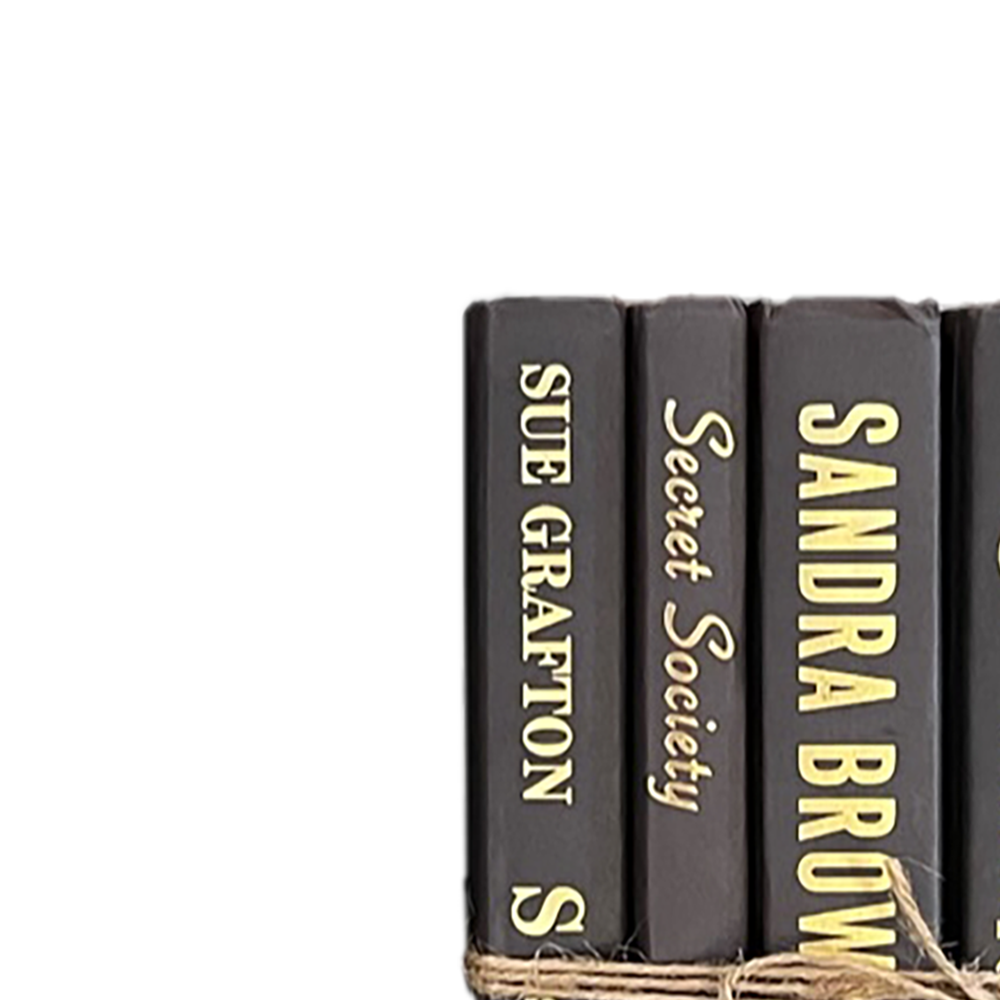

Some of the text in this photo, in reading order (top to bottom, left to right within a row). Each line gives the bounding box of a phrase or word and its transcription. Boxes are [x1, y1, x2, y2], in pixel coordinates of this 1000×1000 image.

[519, 363, 573, 806] SUE GRAFTON
[647, 398, 735, 812] Secret Society
[798, 402, 899, 712] SANDRA
[511, 886, 586, 936] S
